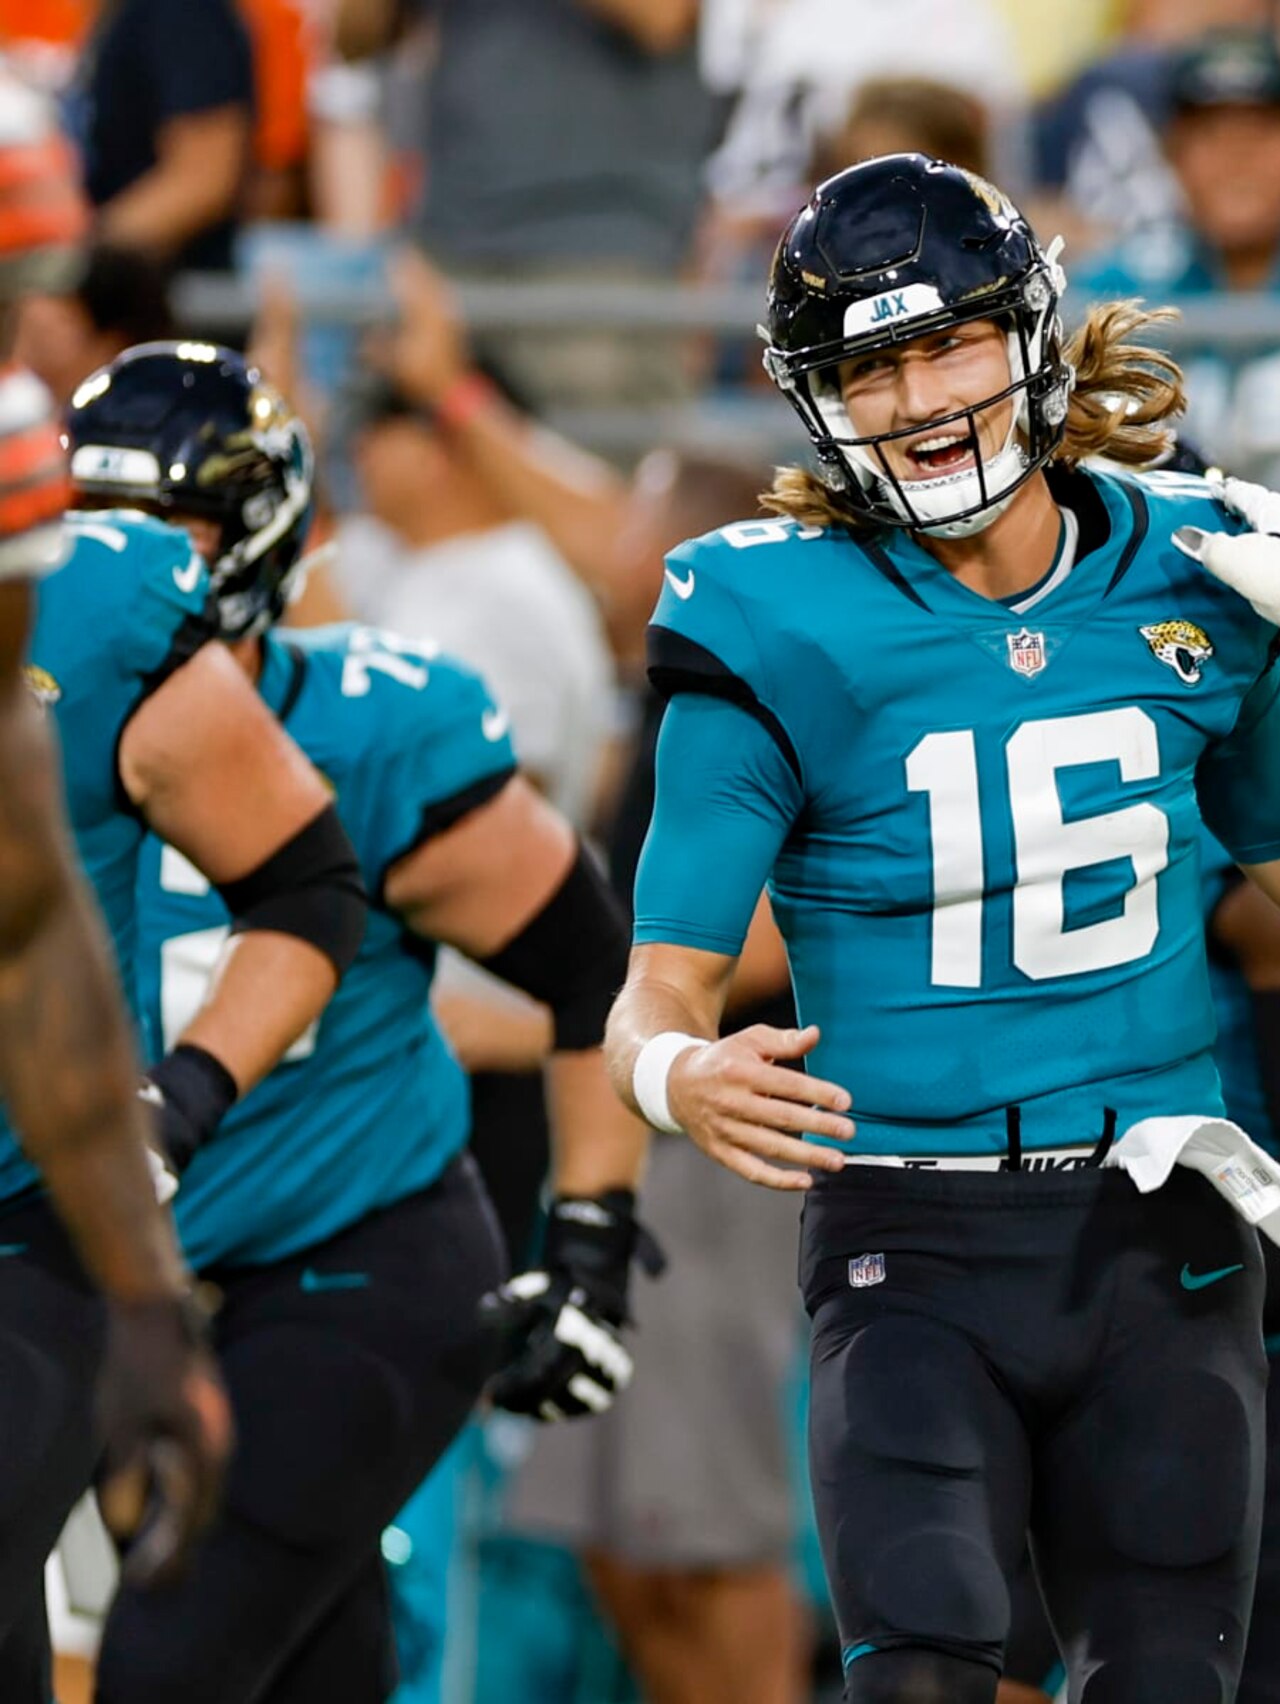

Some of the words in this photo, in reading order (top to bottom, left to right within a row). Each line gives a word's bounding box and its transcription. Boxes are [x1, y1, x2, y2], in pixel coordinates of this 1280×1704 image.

[870, 292, 909, 322] JAX
[1014, 649, 1042, 668] NFL
[905, 706, 1169, 988] 16
[853, 1264, 881, 1281] NFL
